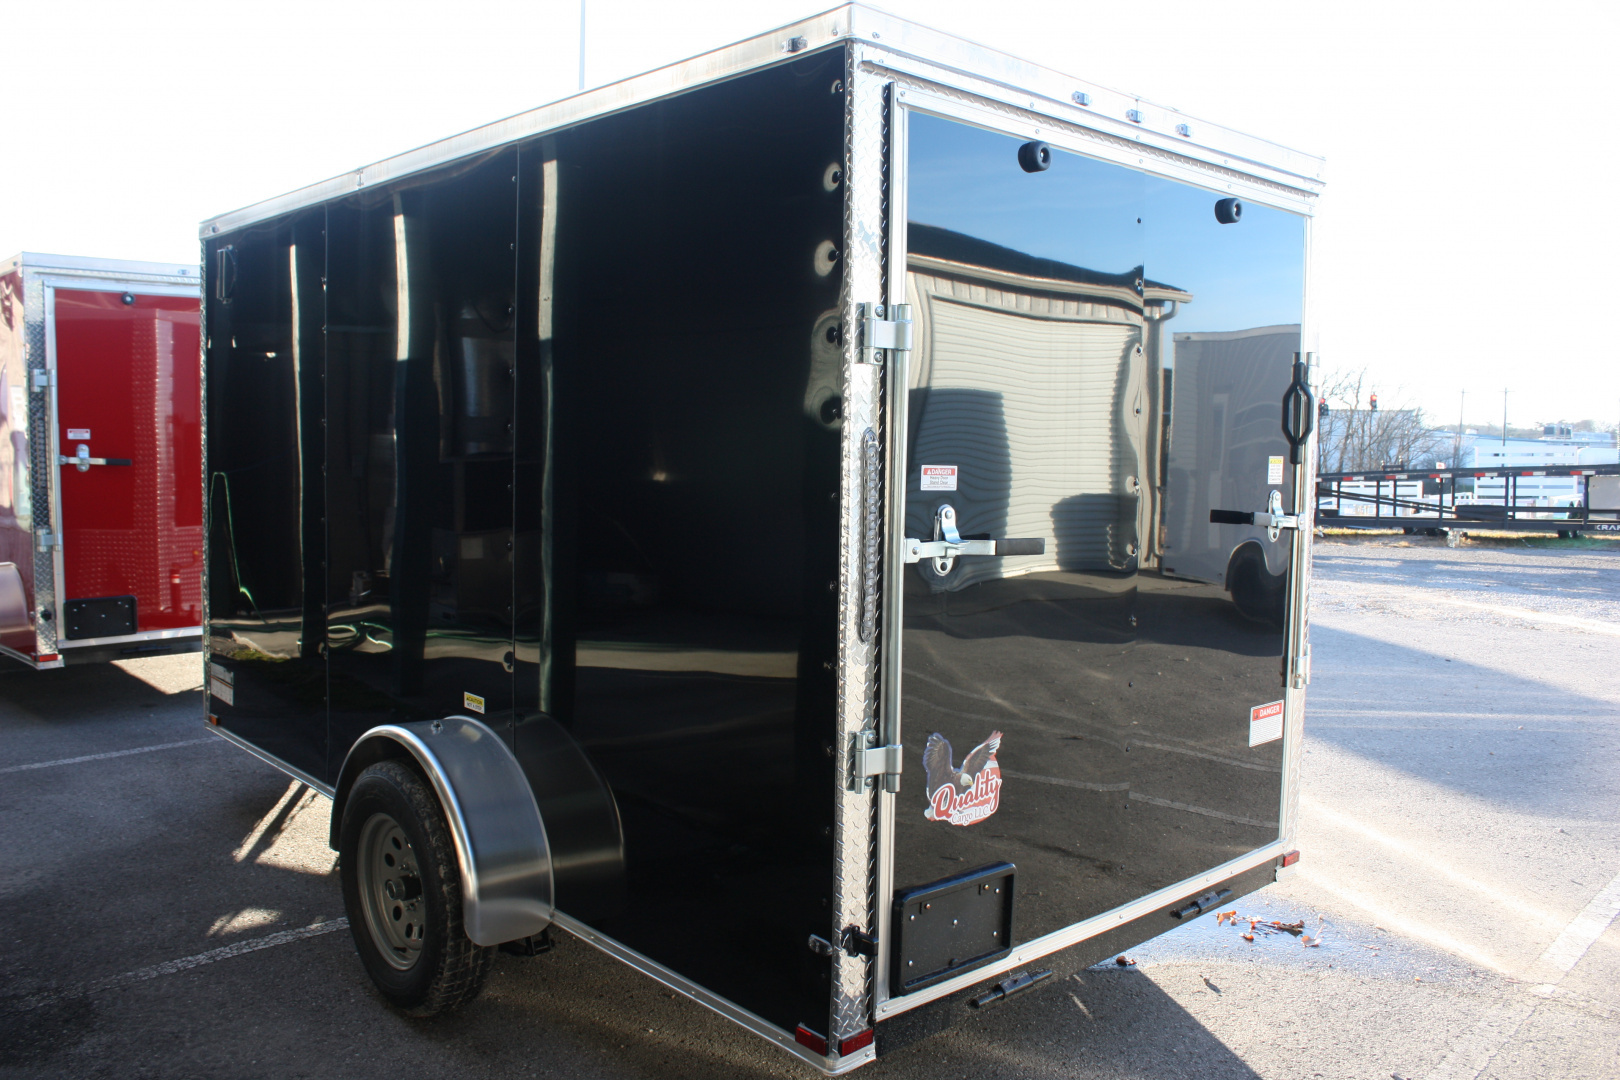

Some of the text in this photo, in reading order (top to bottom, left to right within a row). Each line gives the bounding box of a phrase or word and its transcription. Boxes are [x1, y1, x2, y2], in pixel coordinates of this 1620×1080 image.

[1259, 705, 1280, 717] DANGER
[932, 769, 1002, 819] Quality
[951, 805, 989, 825] Cargo LLC
